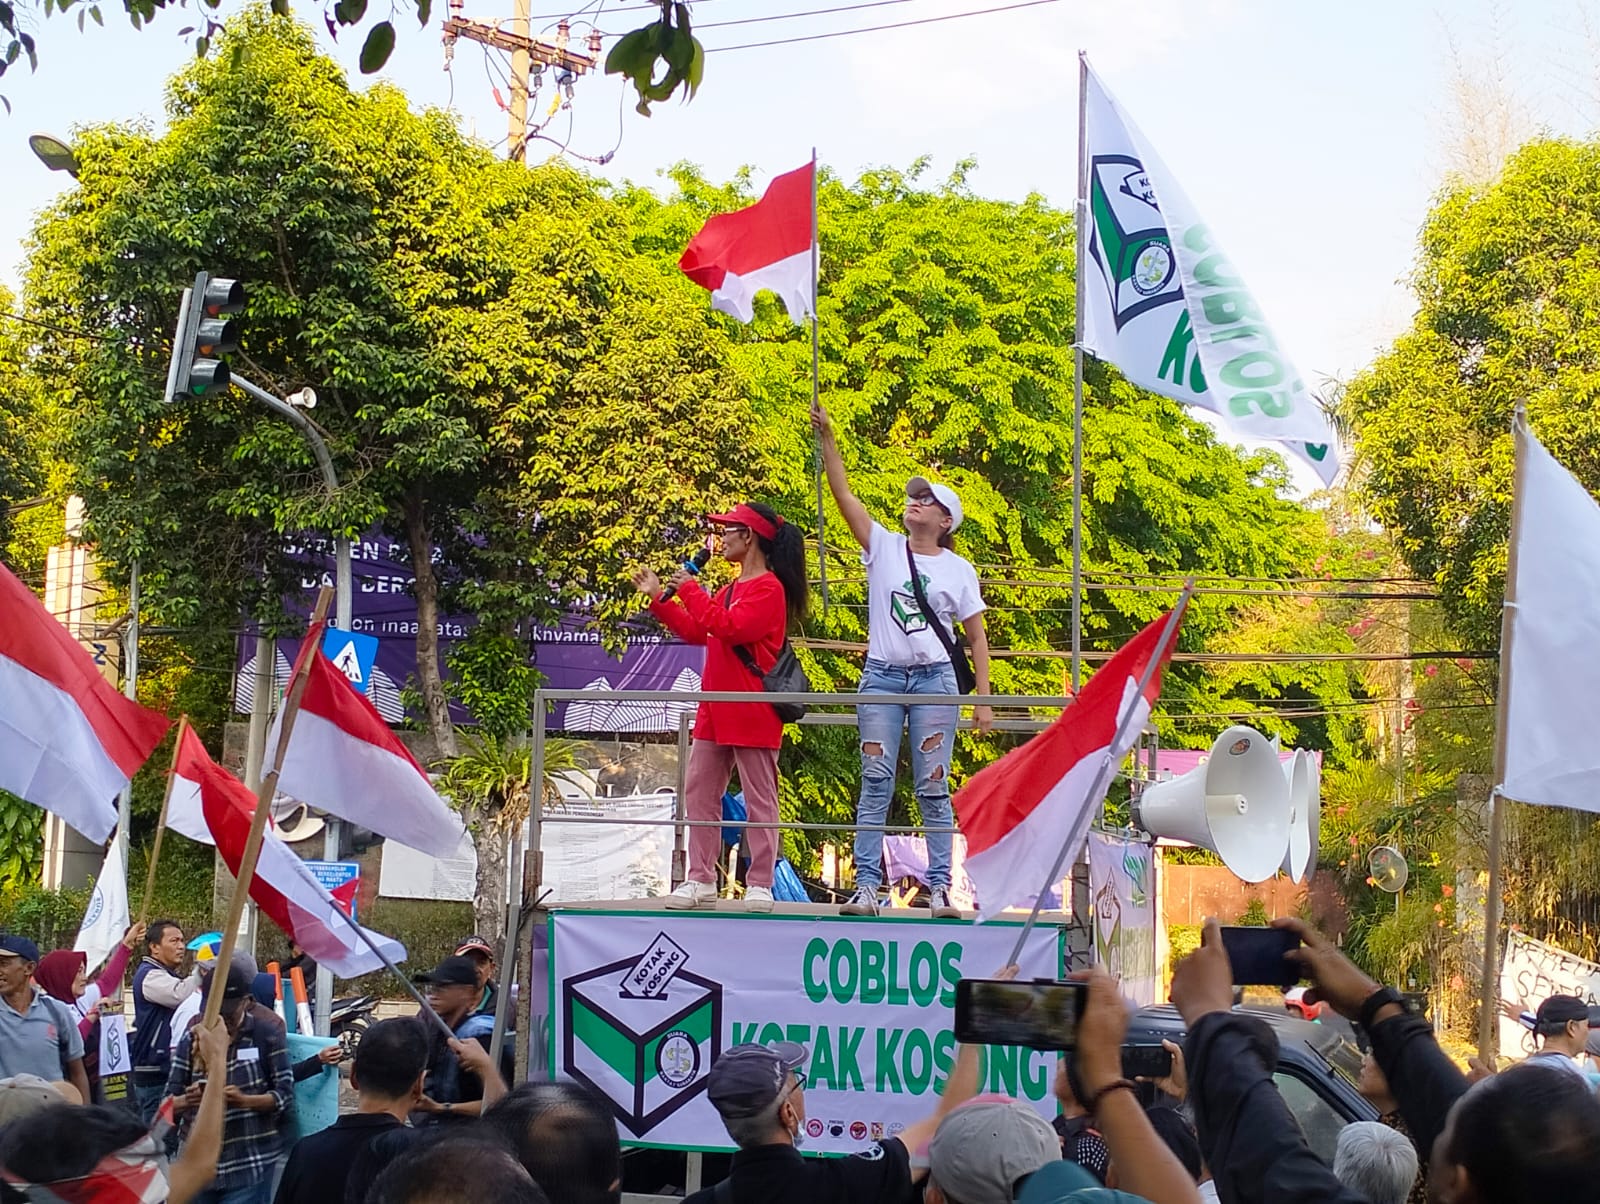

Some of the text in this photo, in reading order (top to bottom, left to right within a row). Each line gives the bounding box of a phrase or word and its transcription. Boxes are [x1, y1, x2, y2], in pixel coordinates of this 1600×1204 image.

[633, 947, 666, 986] KOTAK
[642, 951, 680, 998] KOSONG
[803, 937, 963, 1009] COBLOS
